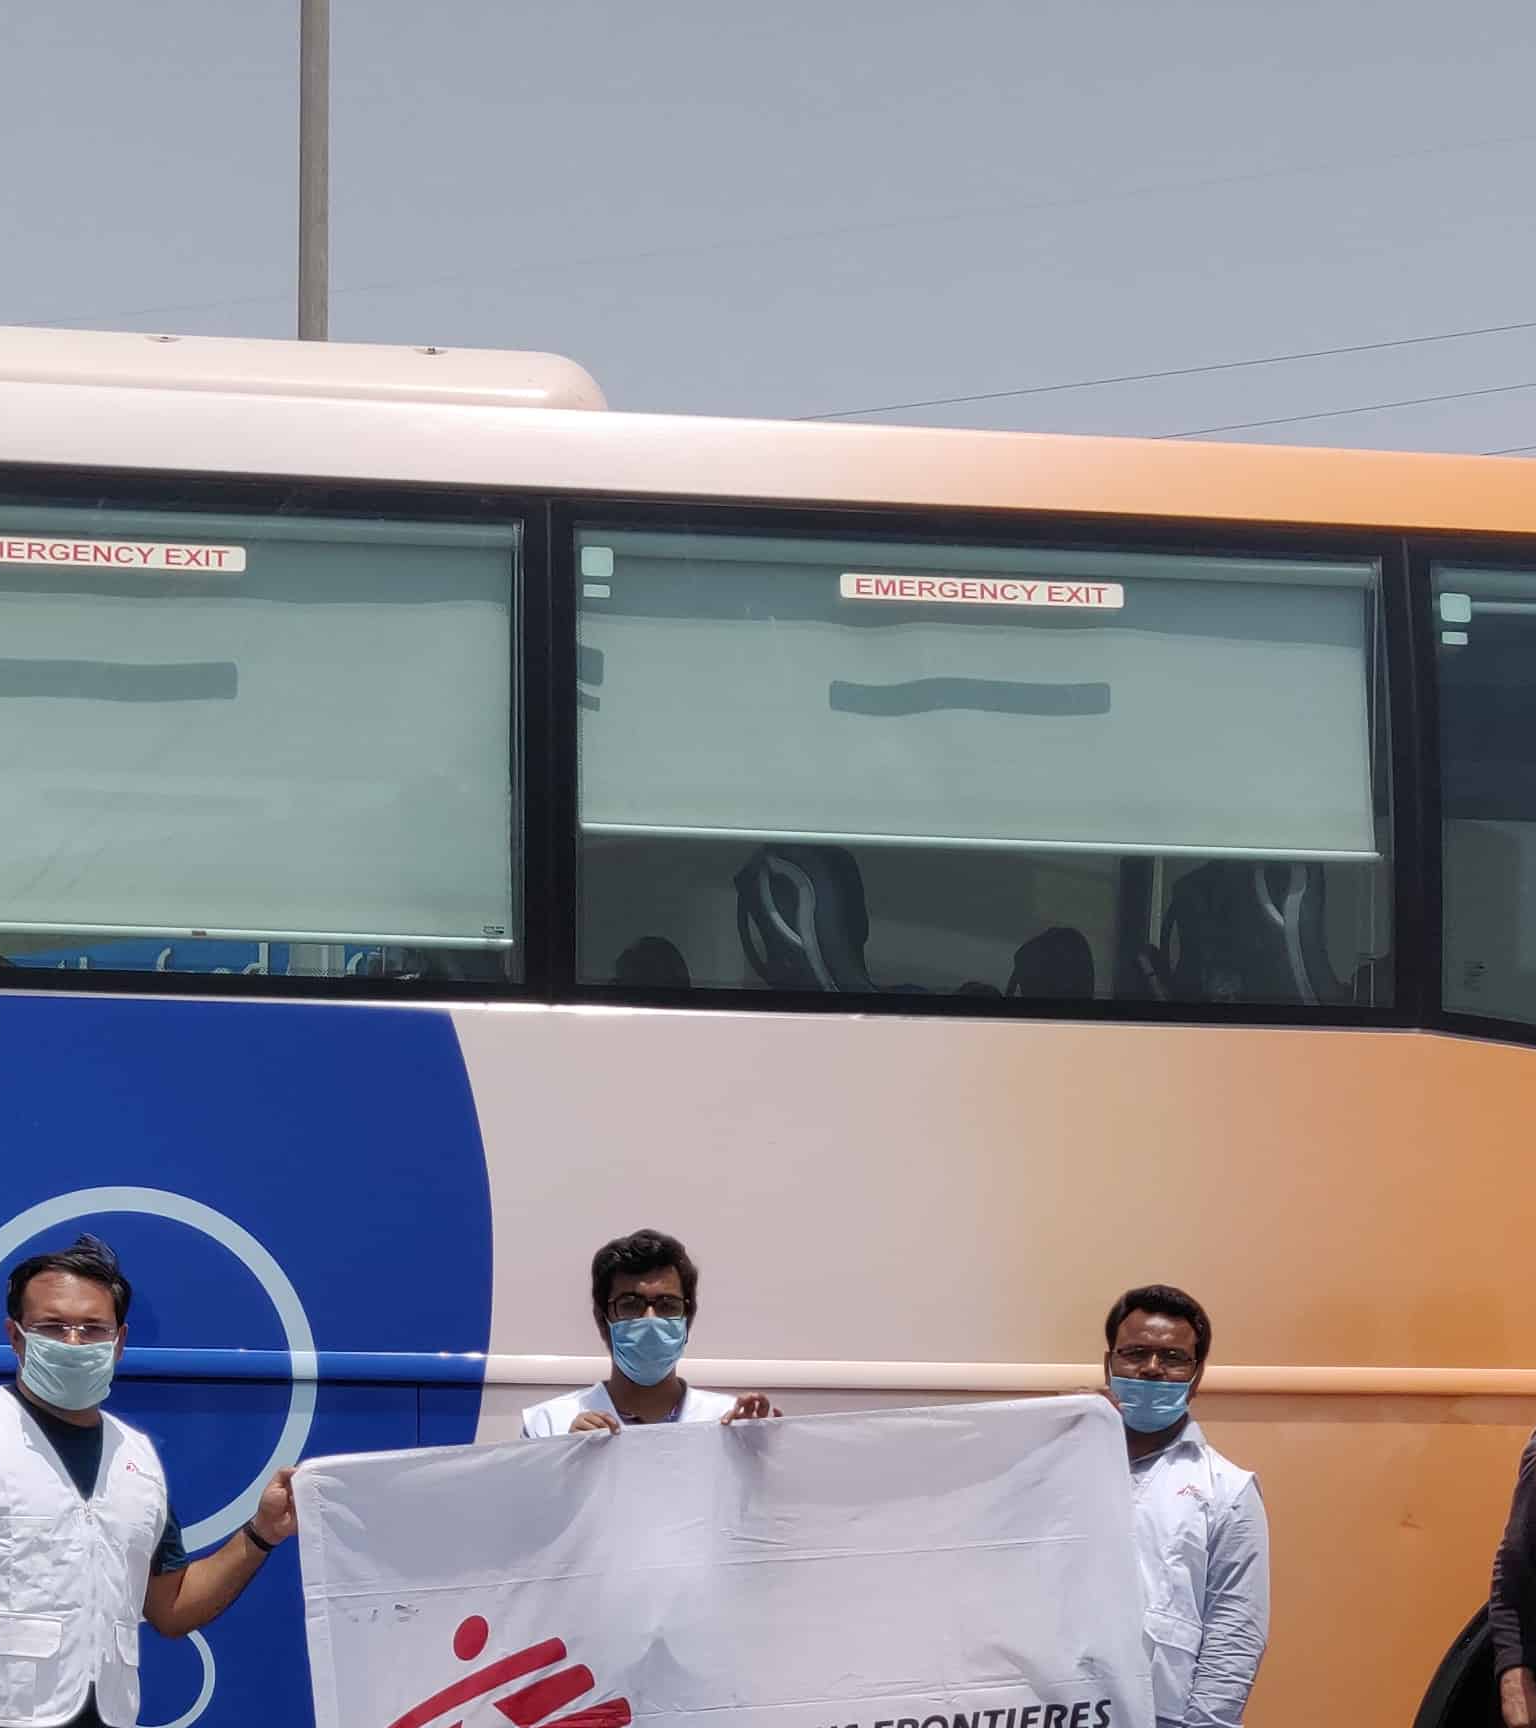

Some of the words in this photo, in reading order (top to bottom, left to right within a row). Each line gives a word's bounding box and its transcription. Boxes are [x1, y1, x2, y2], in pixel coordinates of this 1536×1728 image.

[164, 548, 229, 568] EXIT
[855, 577, 1039, 602] EMERGENCY
[1047, 585, 1109, 604] EXIT
